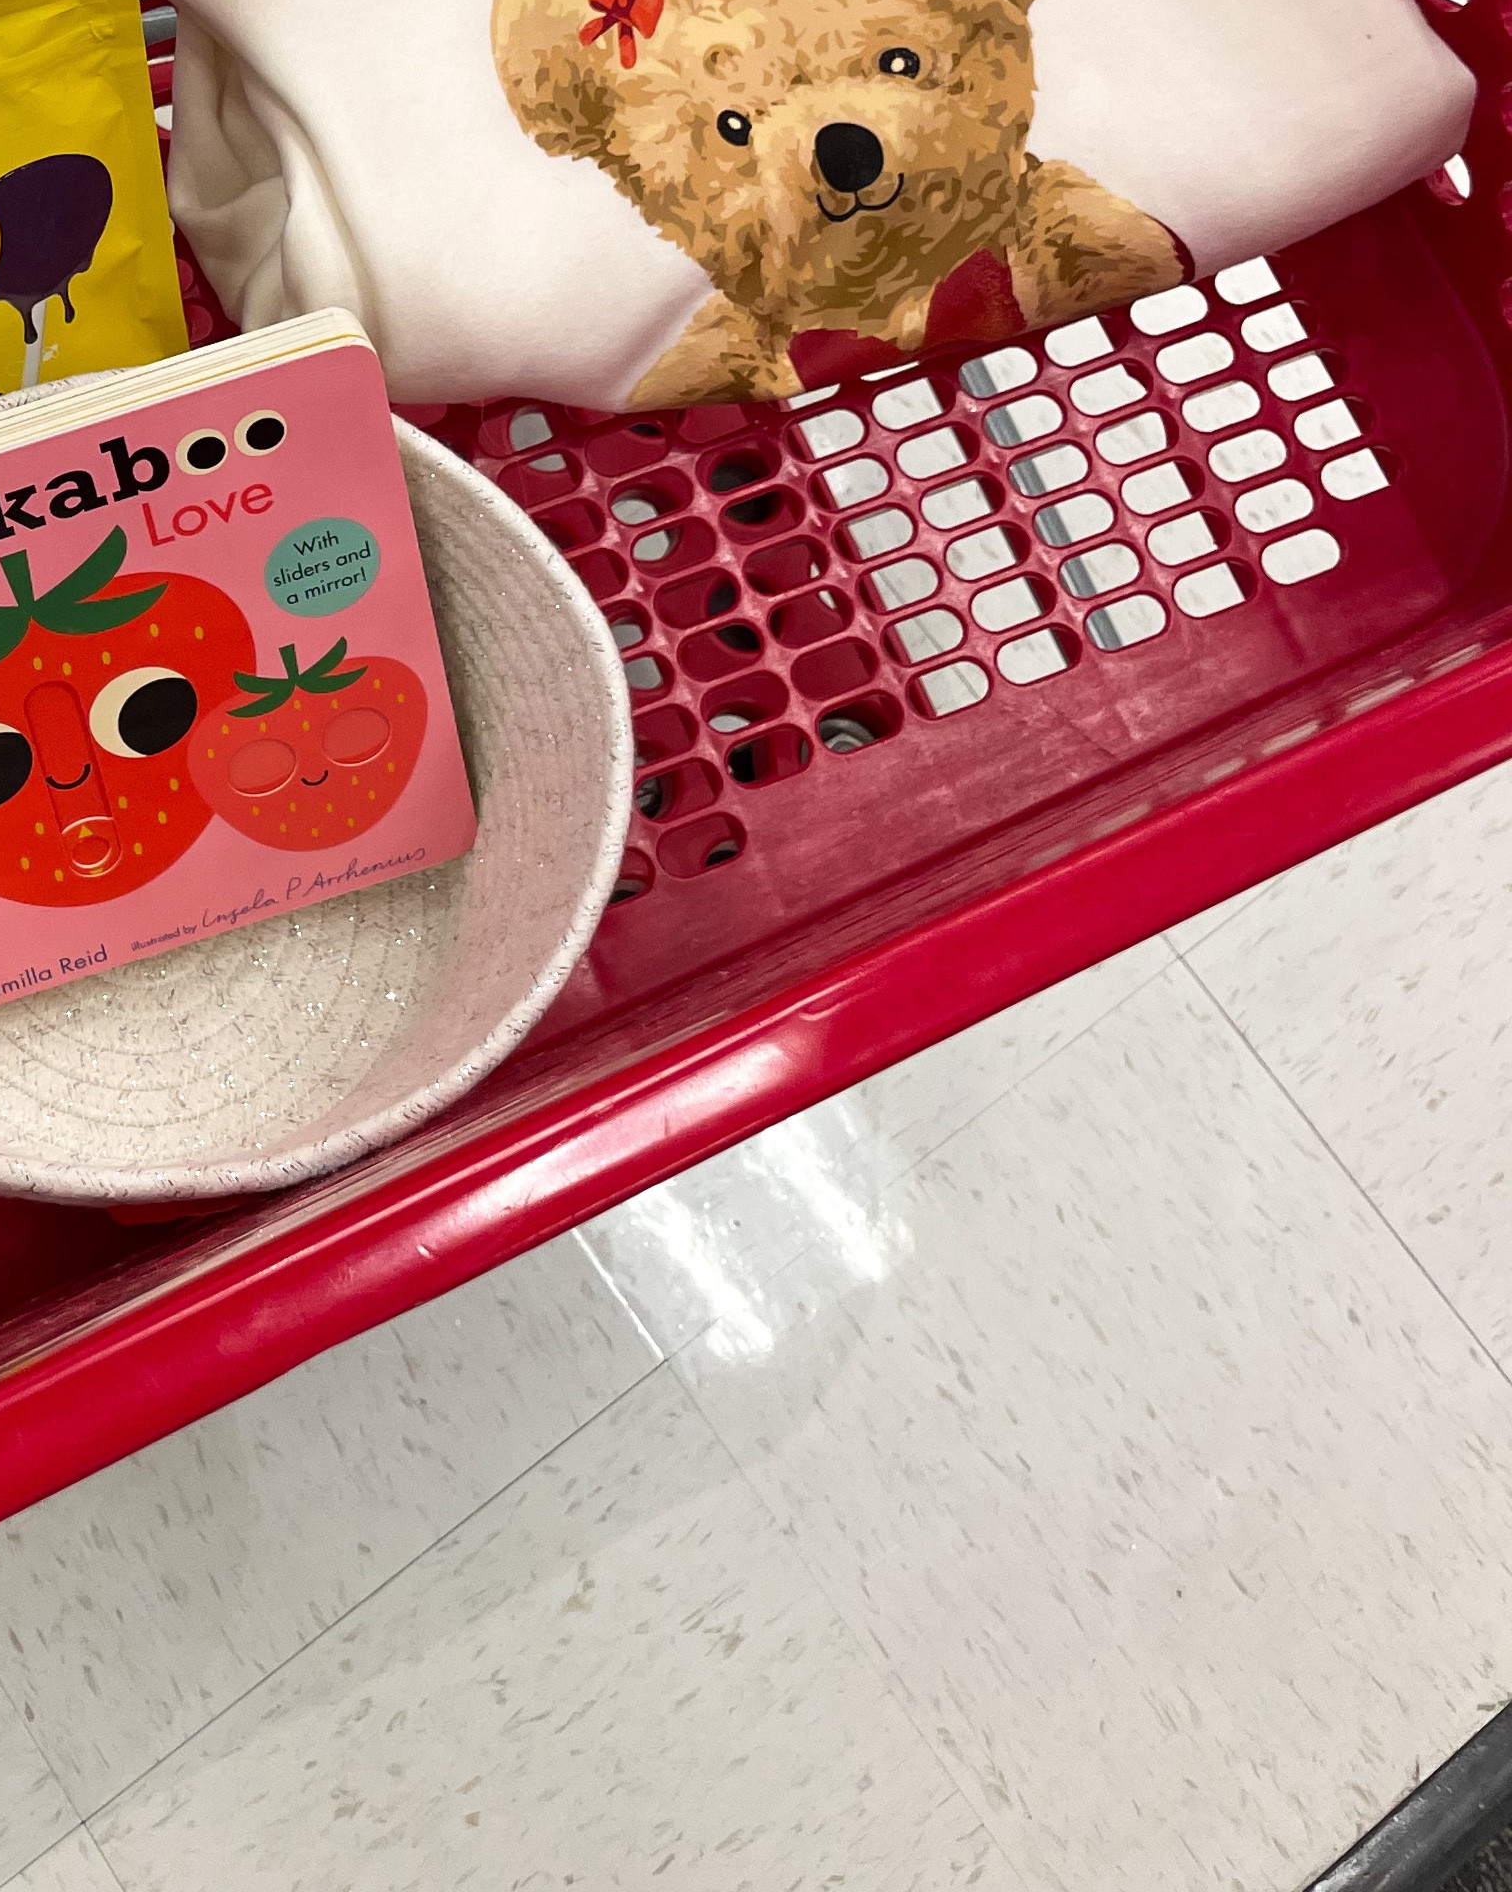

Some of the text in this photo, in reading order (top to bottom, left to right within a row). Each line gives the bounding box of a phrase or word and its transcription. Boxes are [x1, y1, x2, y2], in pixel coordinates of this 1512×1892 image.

[141, 482, 275, 548] Love
[292, 530, 340, 556] With
[273, 540, 371, 587] sliders and
[286, 566, 367, 605] a mirror!
[58, 943, 108, 975] Reid
